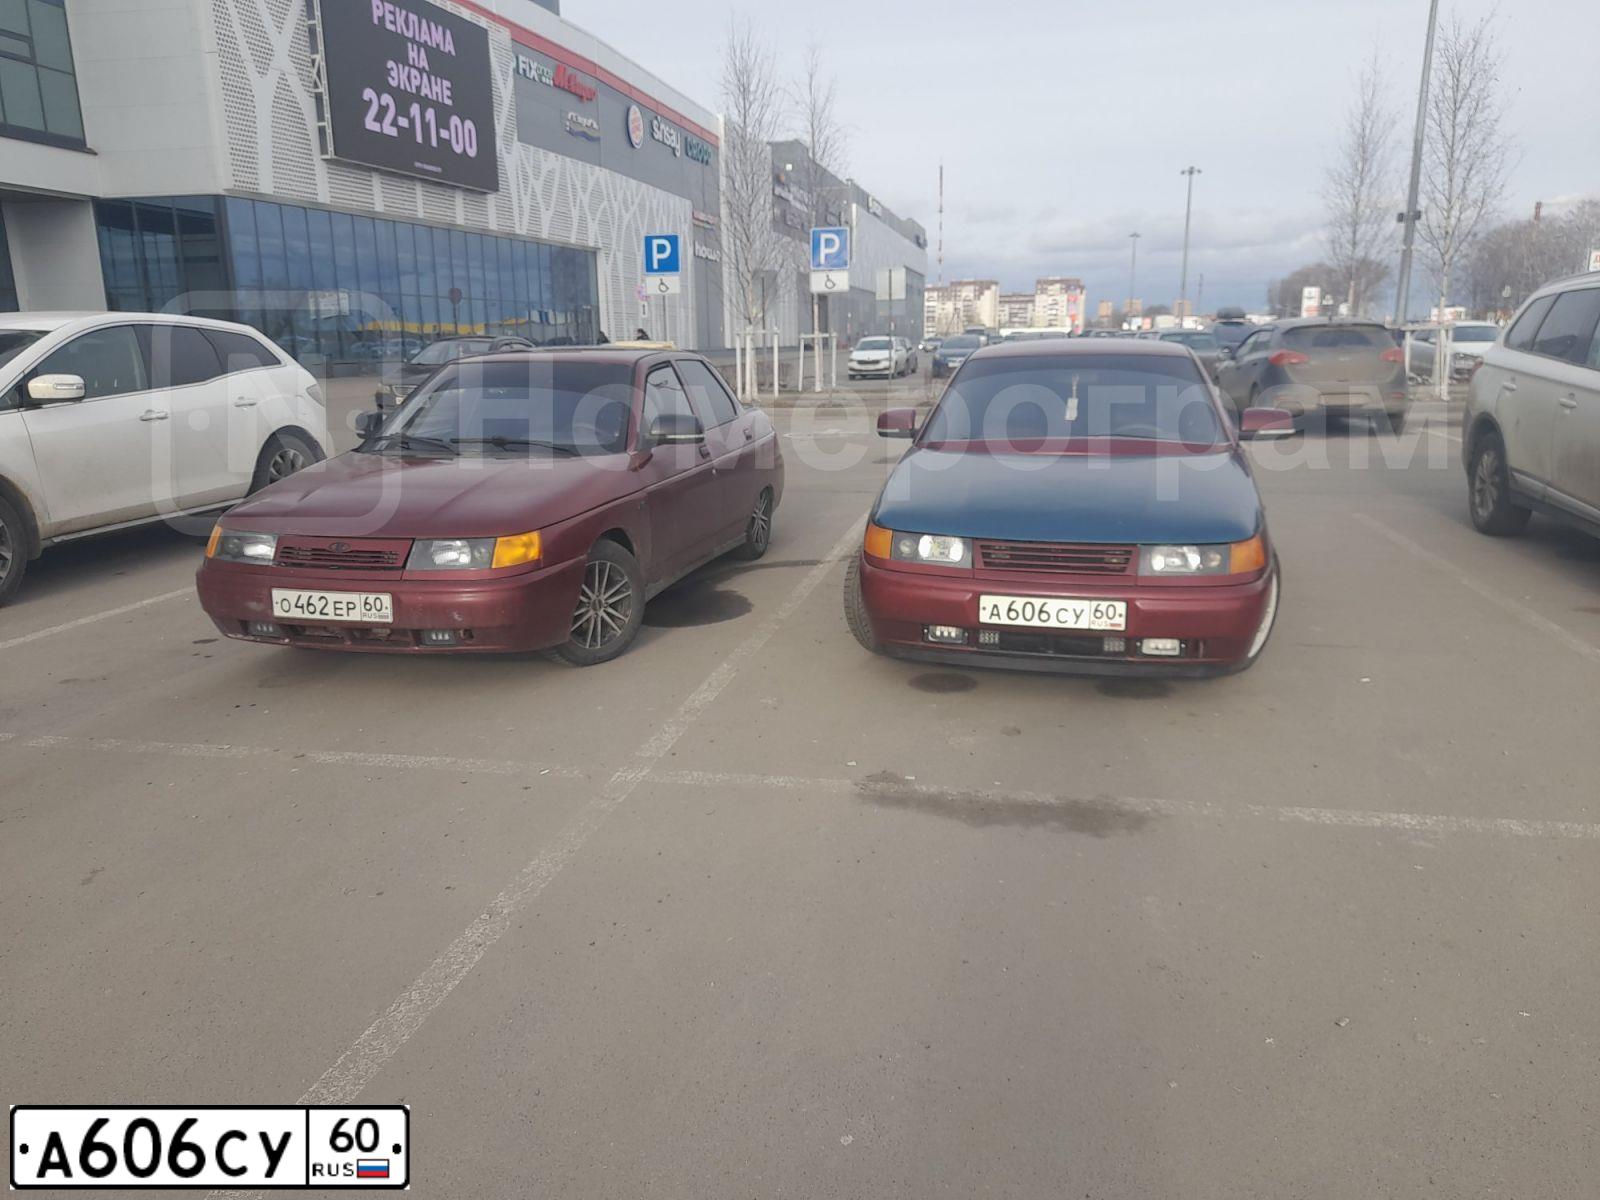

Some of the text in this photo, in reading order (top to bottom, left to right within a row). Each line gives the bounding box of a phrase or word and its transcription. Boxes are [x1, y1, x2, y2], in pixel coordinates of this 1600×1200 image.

[371, 0, 456, 56] РЕКЛАМА
[407, 43, 430, 73] НА
[517, 54, 539, 82] FIX
[386, 60, 453, 106] ЭКРАНЕ
[362, 88, 477, 158] 22-11-00
[651, 238, 671, 269] P
[819, 233, 841, 264] P
[281, 594, 383, 617] О462ЕР 60
[988, 600, 1117, 624] А606СУ 60
